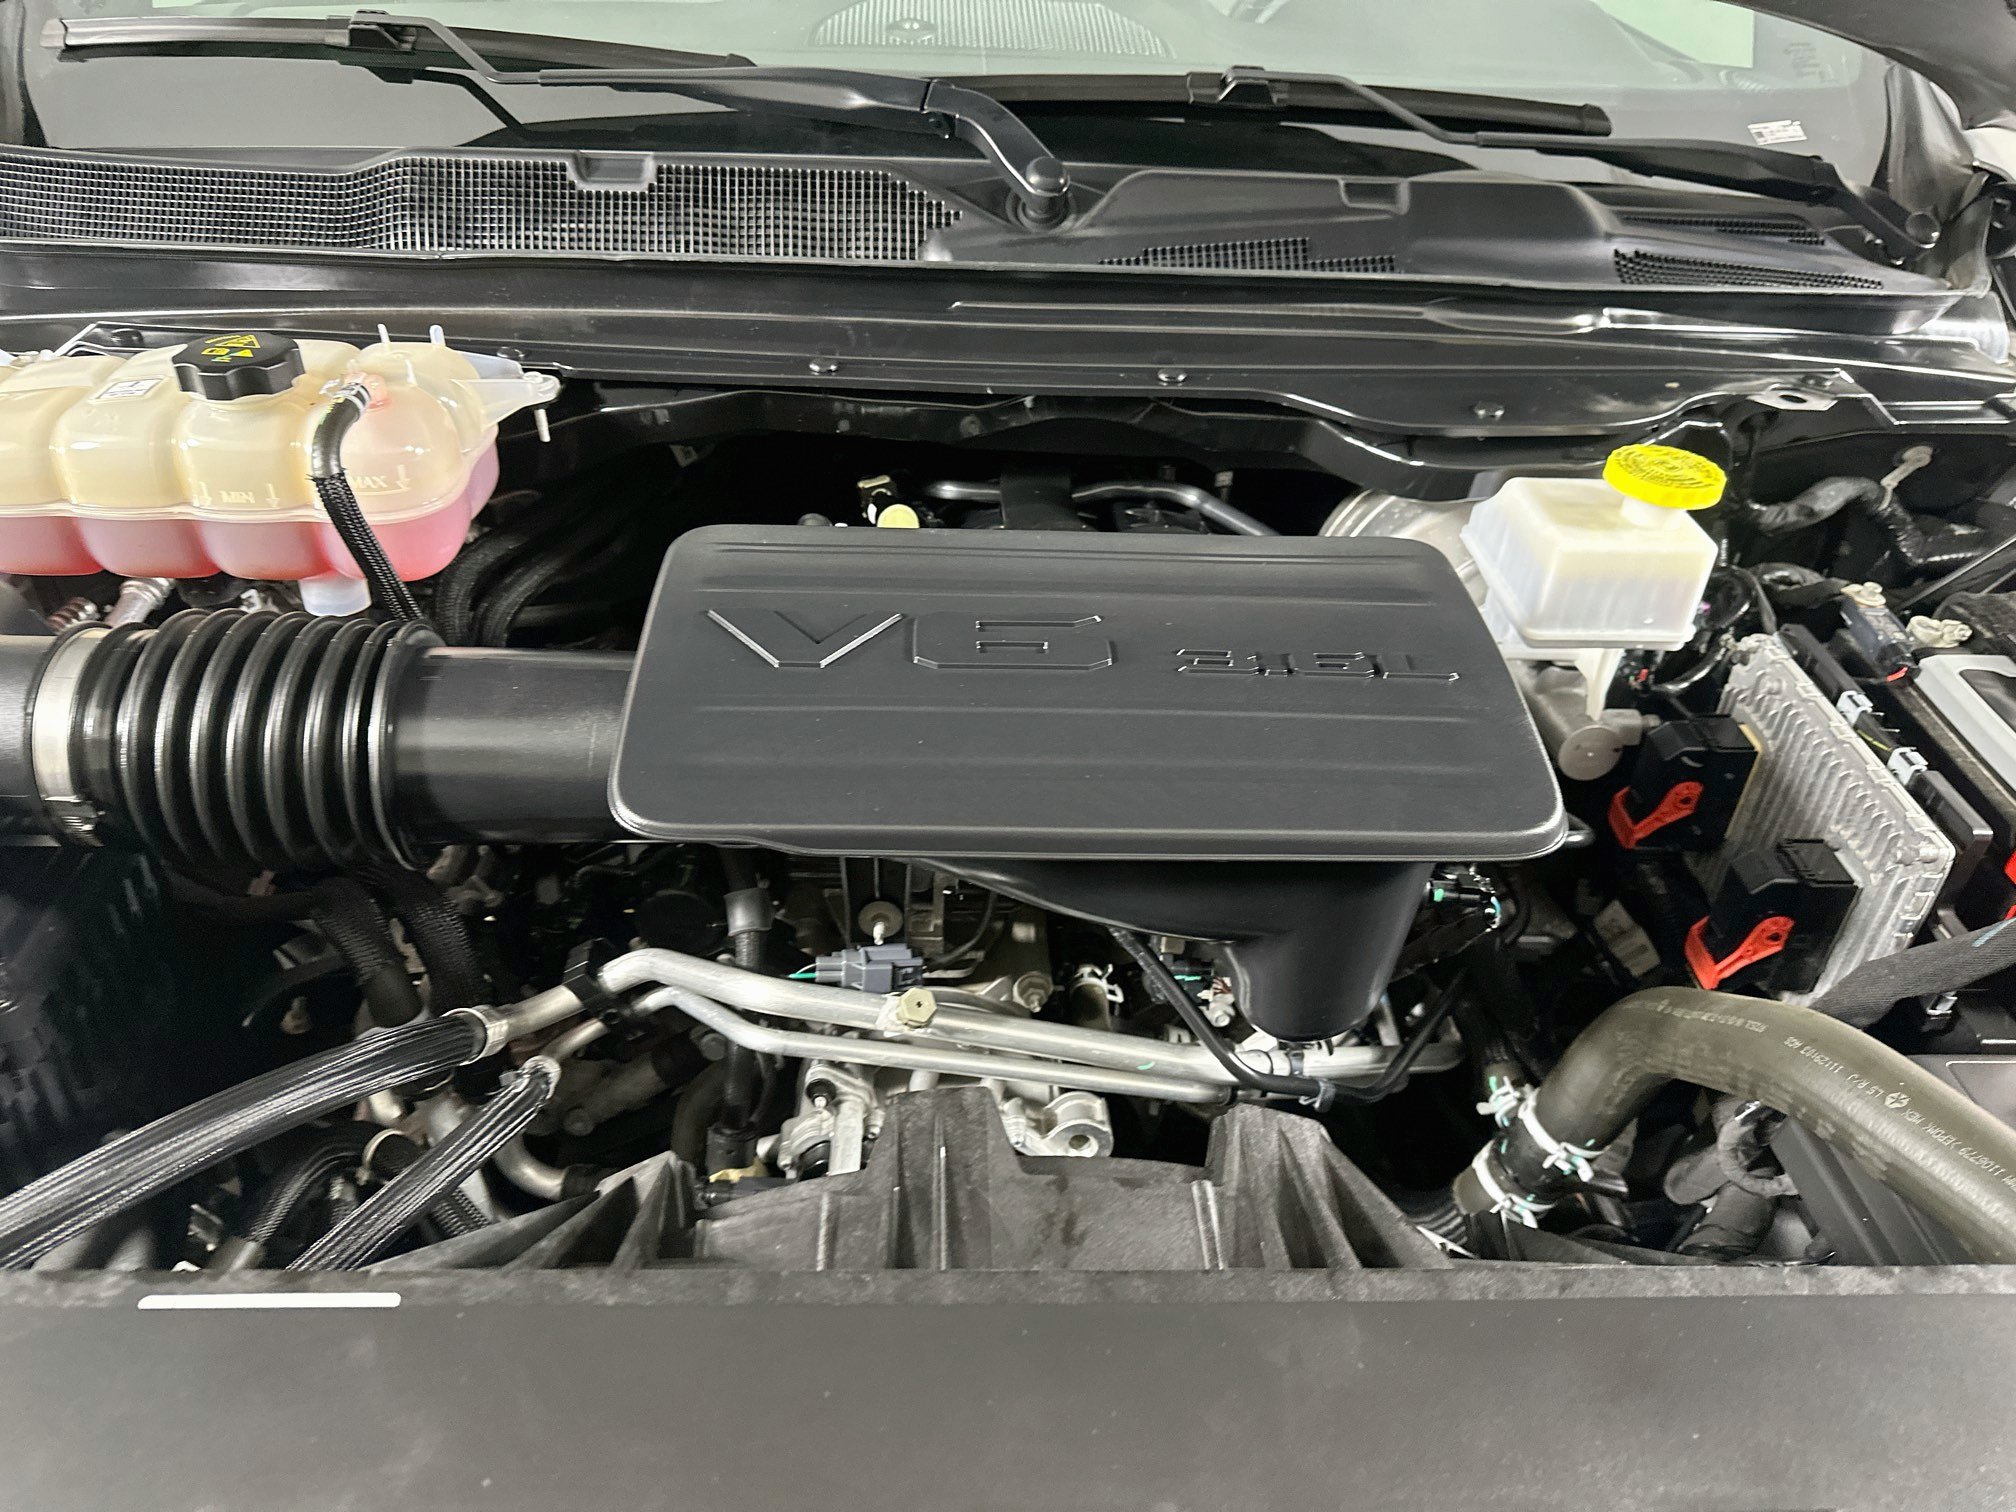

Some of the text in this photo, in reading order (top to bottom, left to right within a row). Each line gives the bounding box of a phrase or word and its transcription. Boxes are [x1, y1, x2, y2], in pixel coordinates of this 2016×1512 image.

[348, 475, 388, 489] MAX
[219, 490, 256, 504] MIN
[706, 608, 1115, 670] V6
